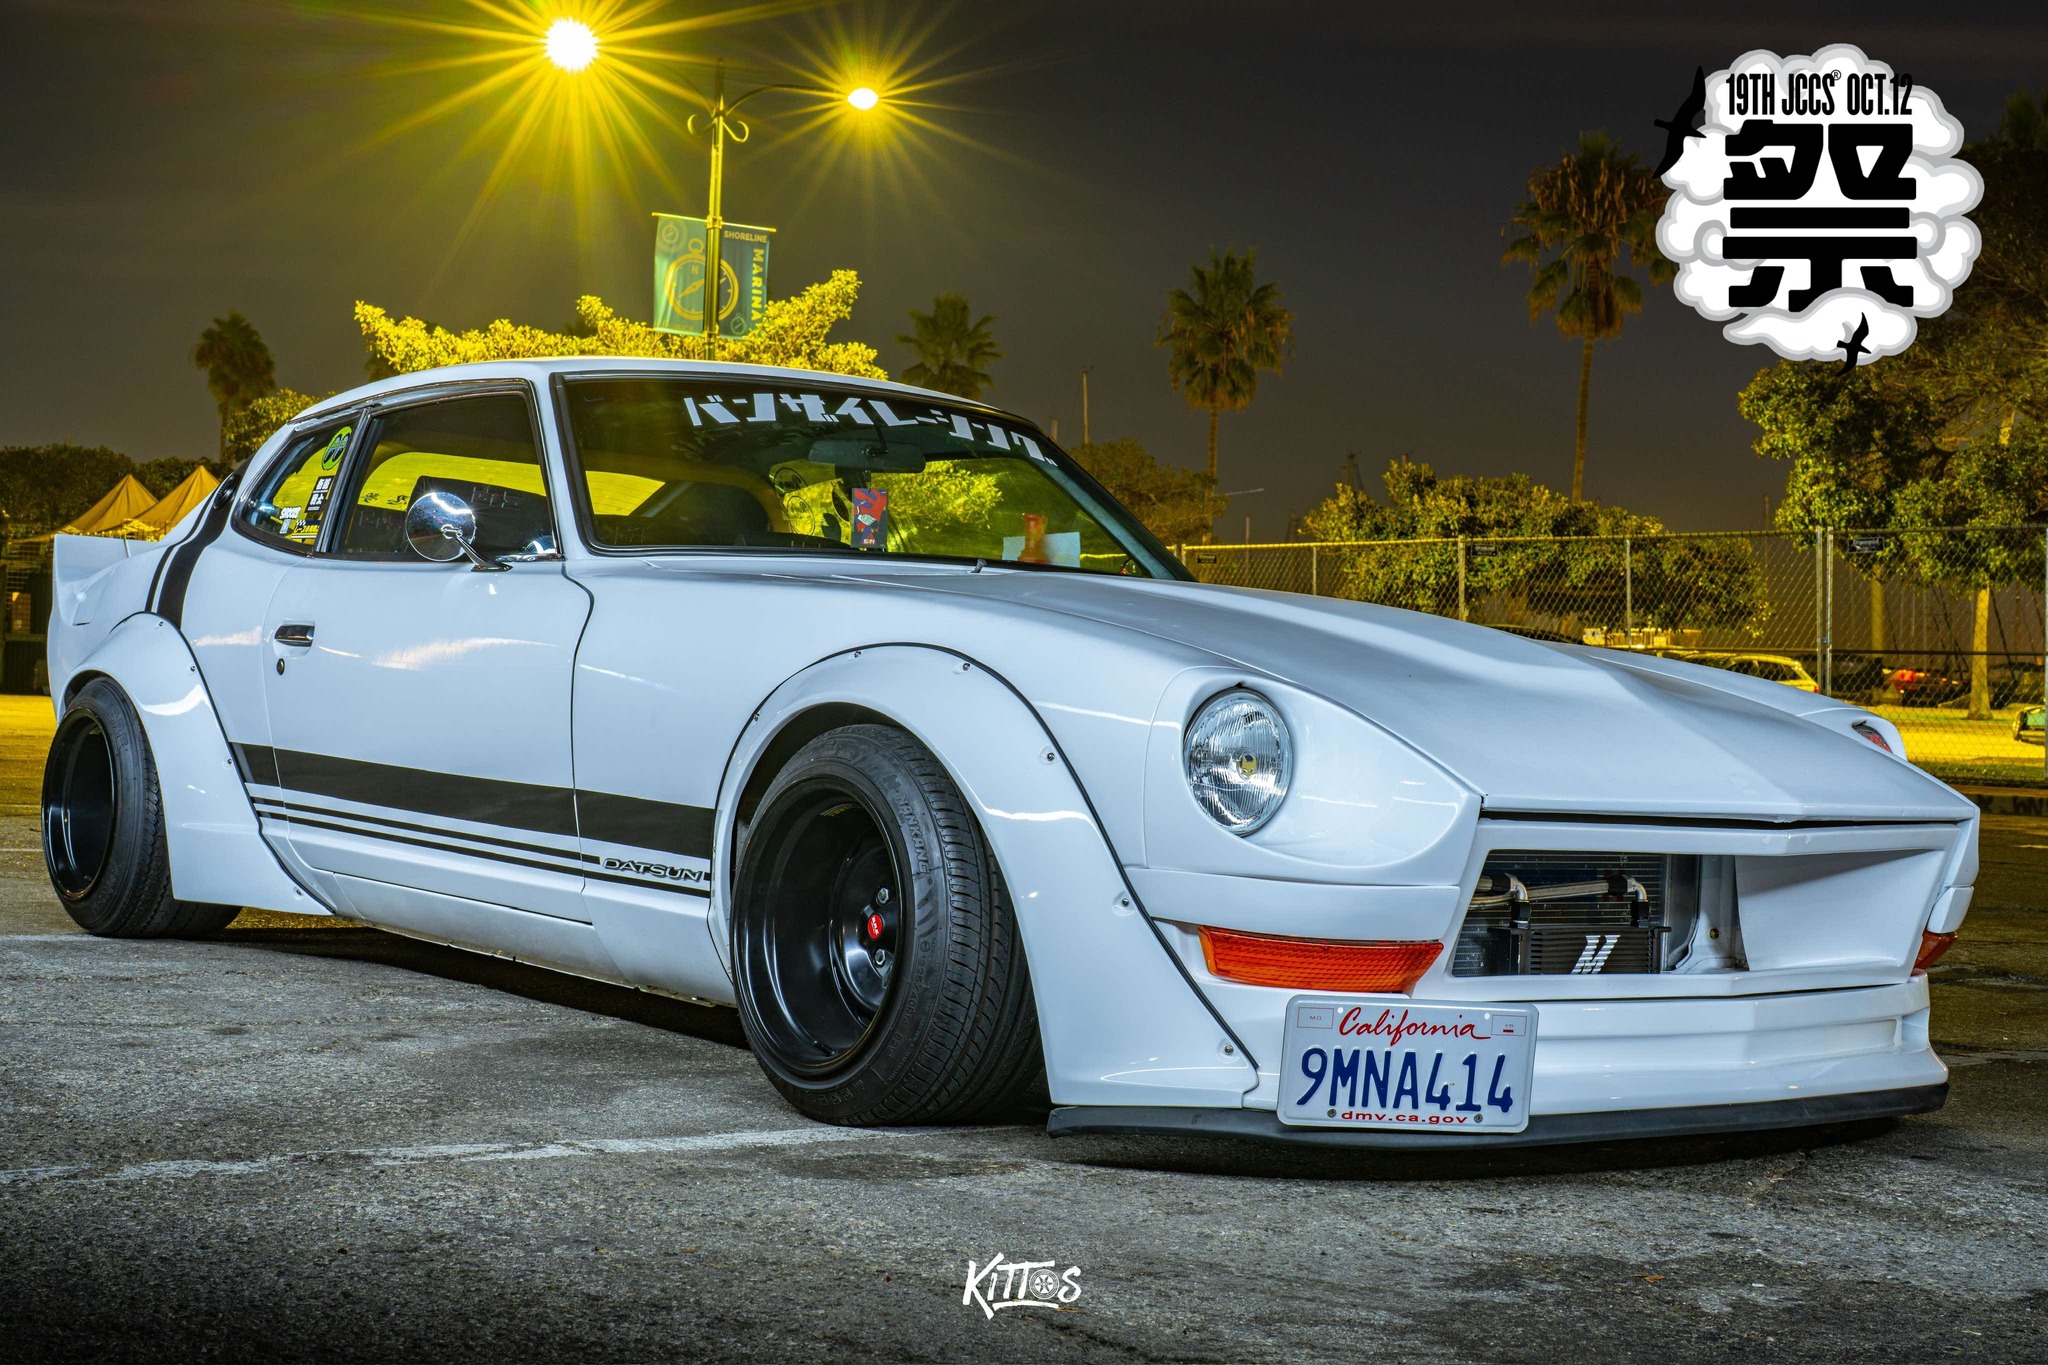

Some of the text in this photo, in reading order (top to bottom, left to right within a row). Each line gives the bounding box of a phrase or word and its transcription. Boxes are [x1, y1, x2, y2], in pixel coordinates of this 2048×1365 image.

[723, 230, 768, 244] SHORELINE
[751, 248, 765, 321] MARINA
[683, 393, 1059, 467] バンザイレーシング
[896, 794, 929, 874] NANKANG
[602, 857, 704, 882] DATSUN
[1338, 1006, 1491, 1047] California
[1296, 1046, 1514, 1113] 9MNA414
[1341, 1110, 1468, 1125] dmv.ca.gov
